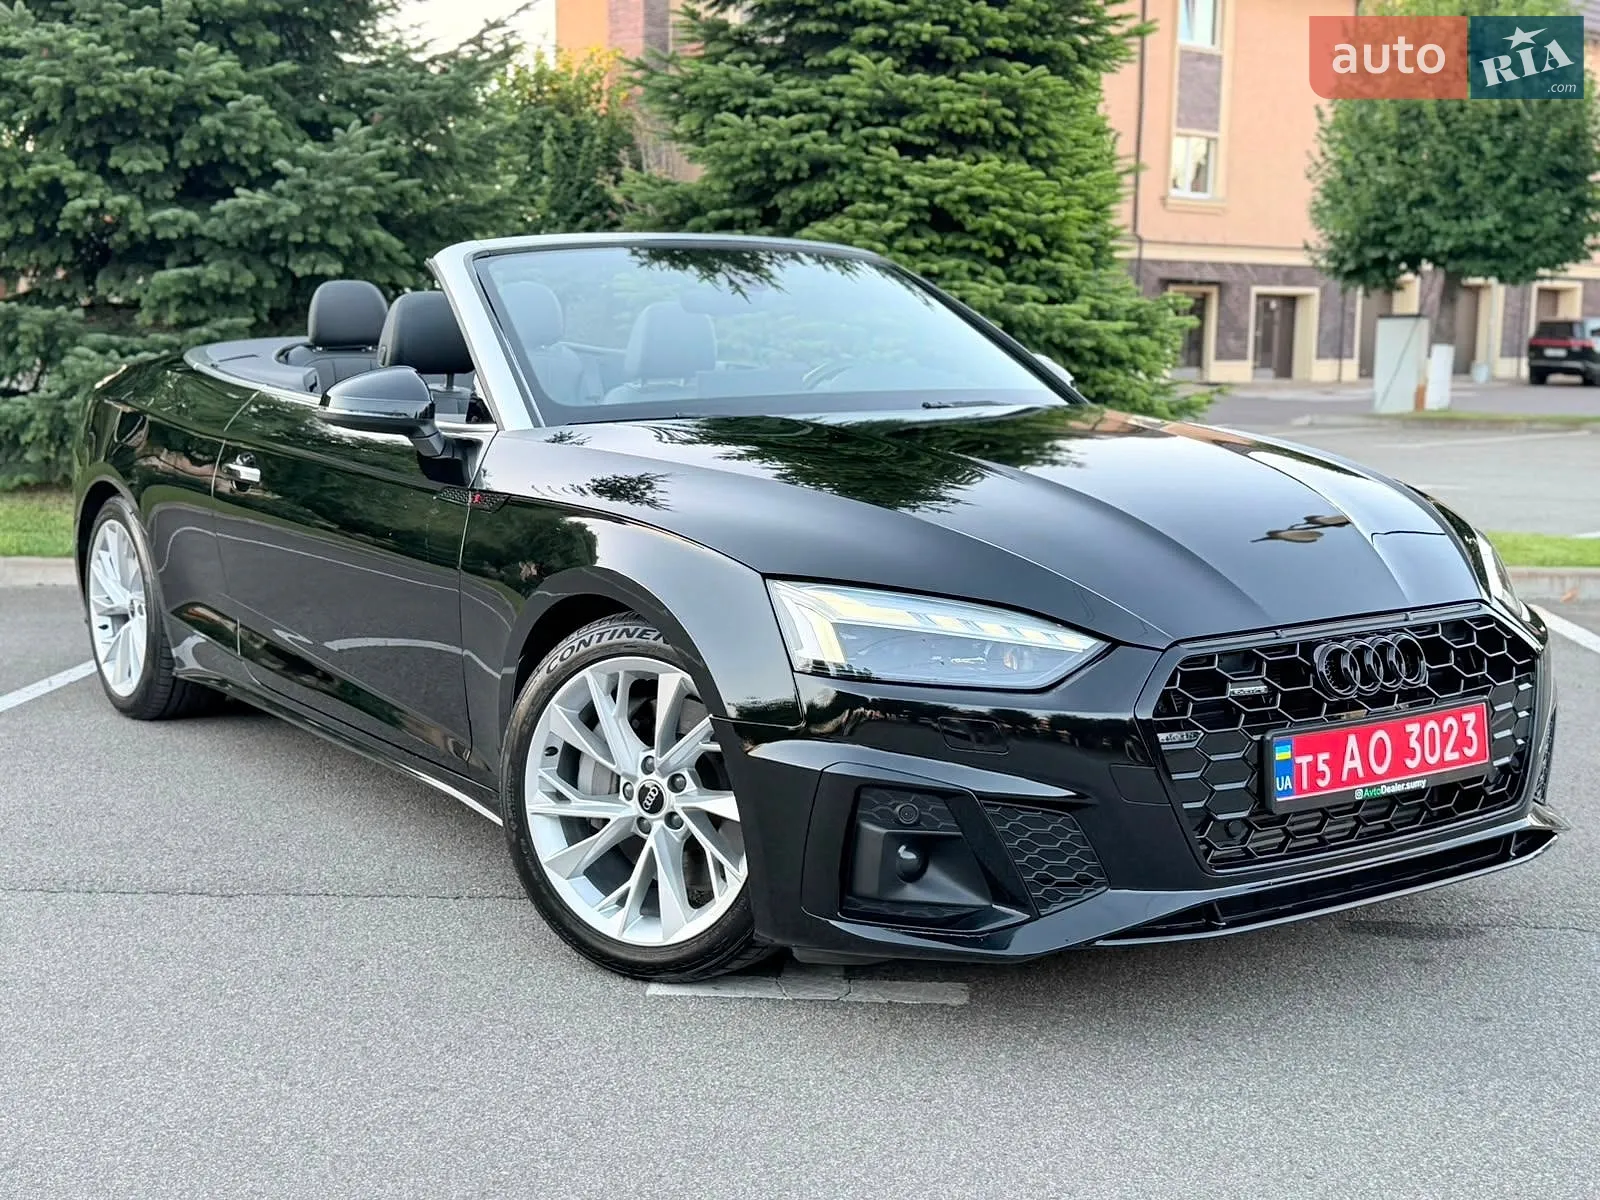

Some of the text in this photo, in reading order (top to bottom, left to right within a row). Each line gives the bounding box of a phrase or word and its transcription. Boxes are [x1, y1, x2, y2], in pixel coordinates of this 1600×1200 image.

[1295, 712, 1478, 790] T5 AO 3023
[1276, 776, 1292, 791] UA
